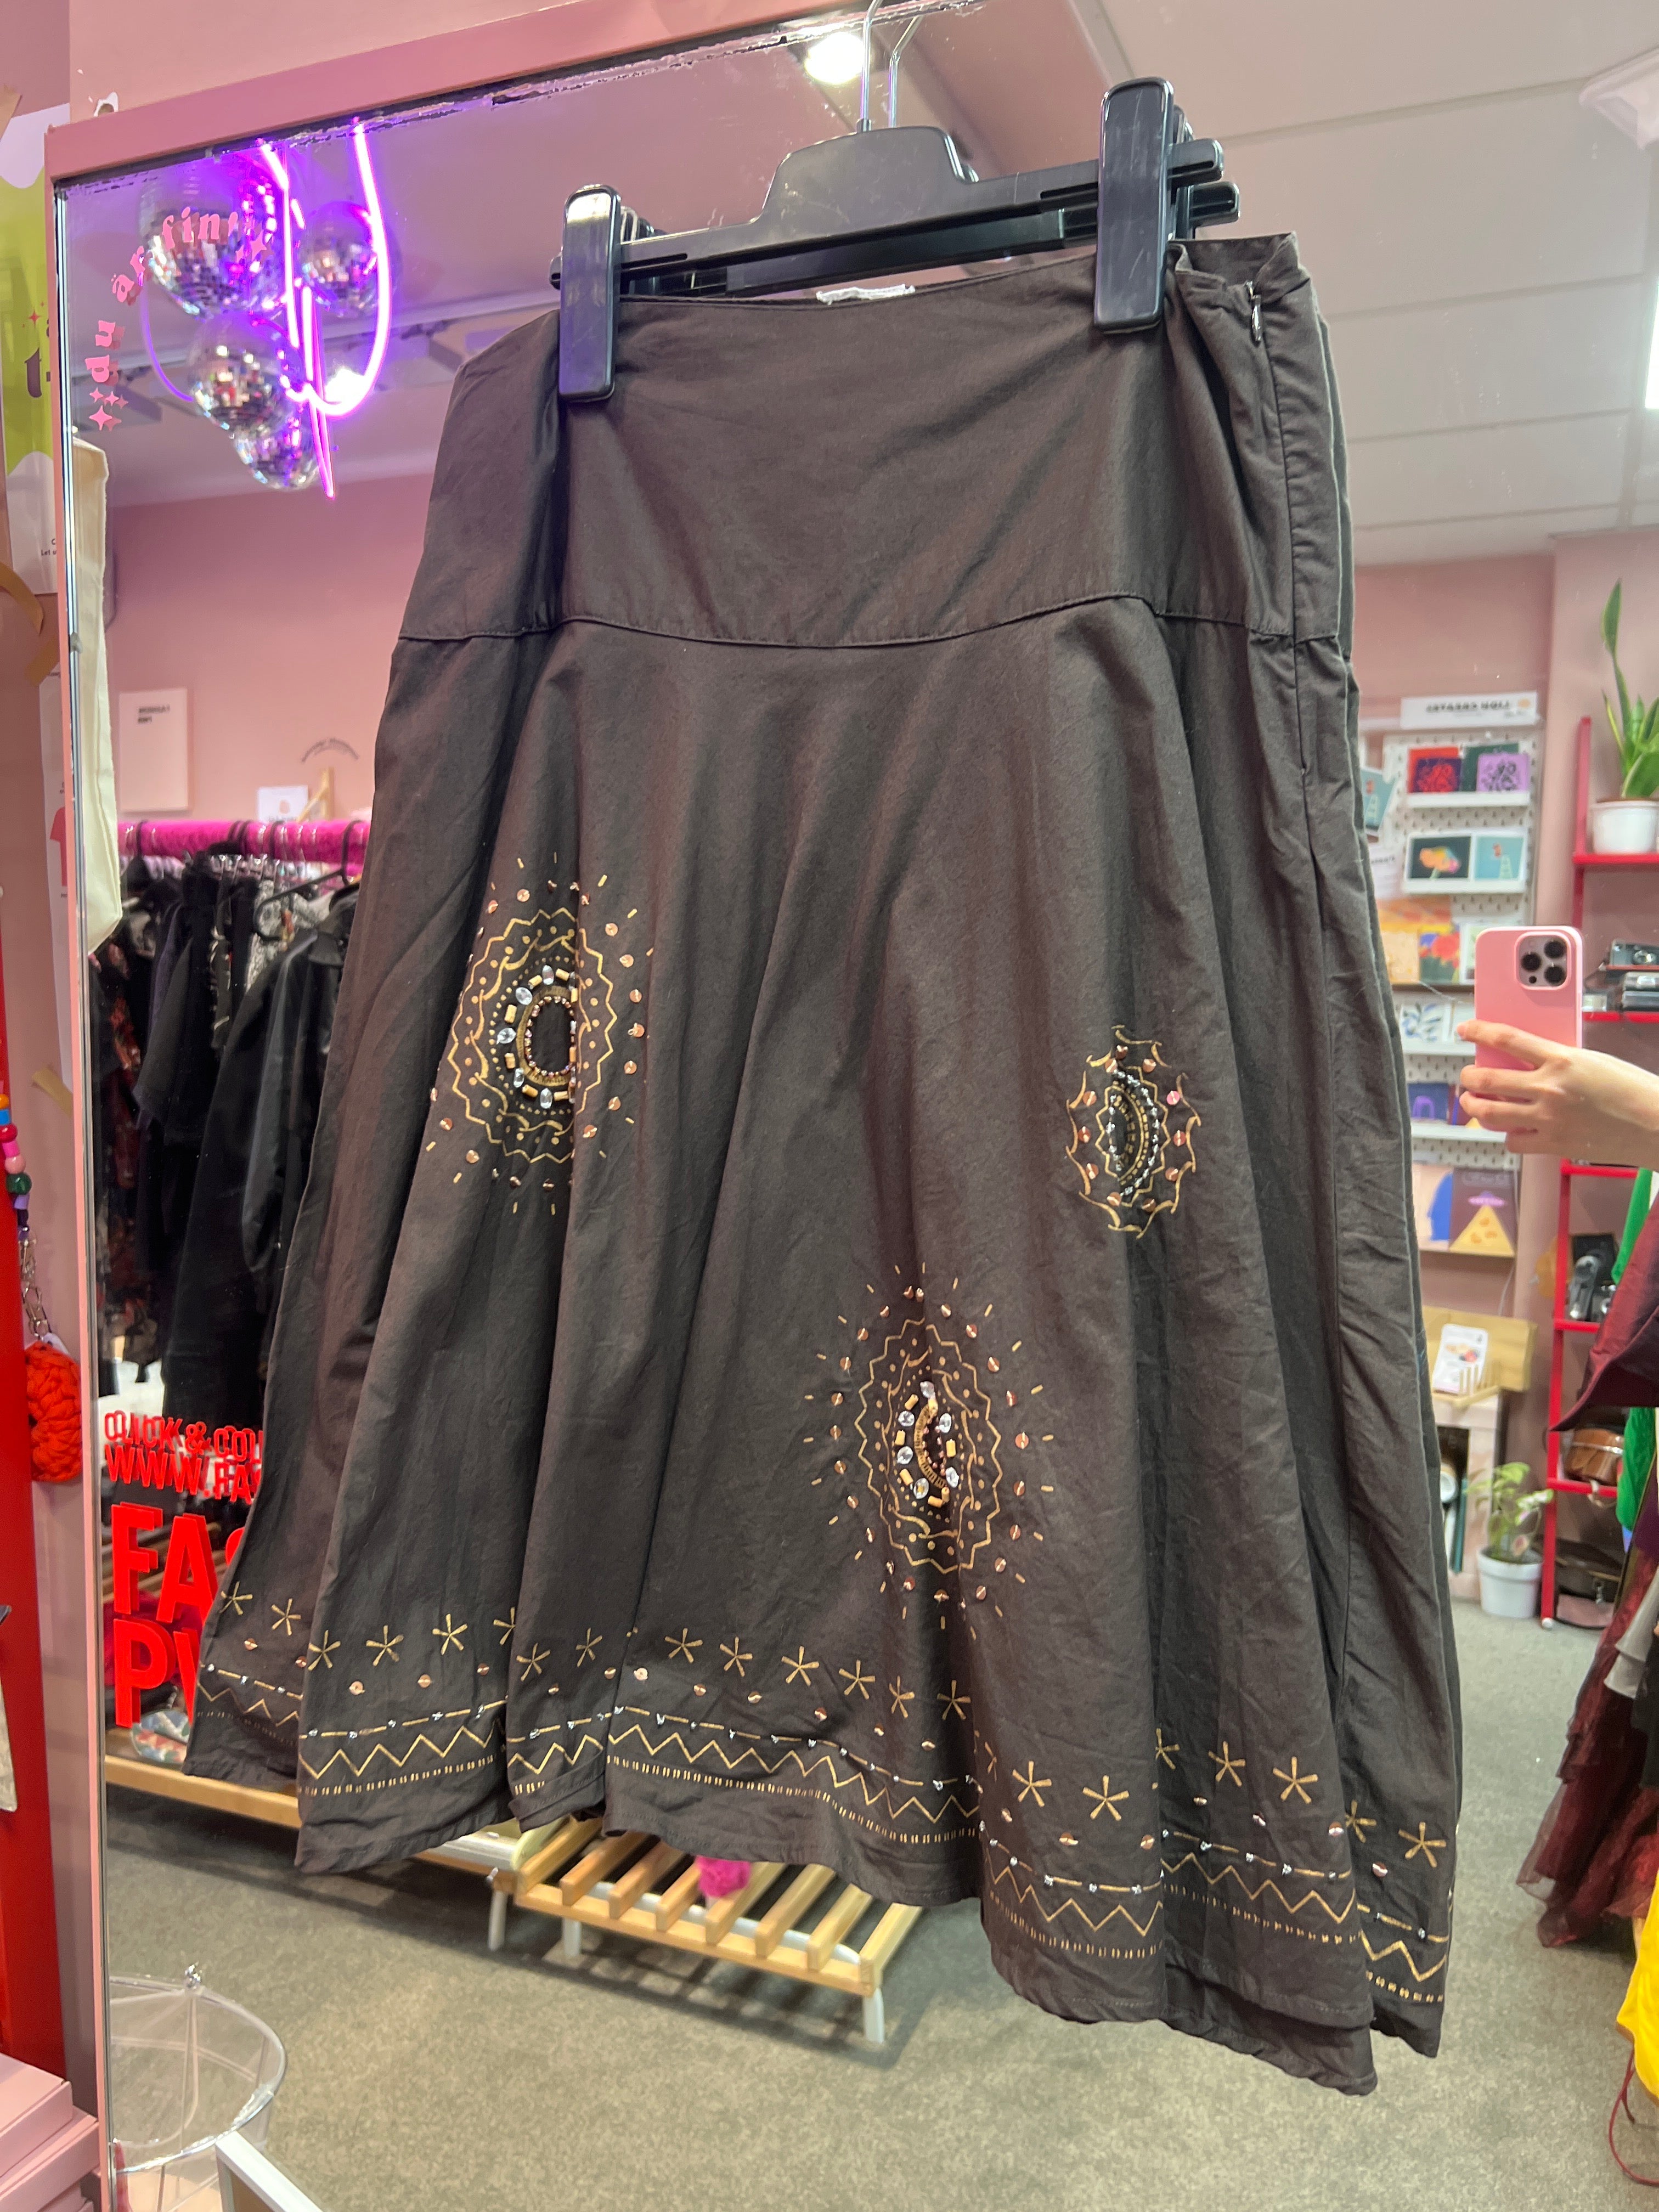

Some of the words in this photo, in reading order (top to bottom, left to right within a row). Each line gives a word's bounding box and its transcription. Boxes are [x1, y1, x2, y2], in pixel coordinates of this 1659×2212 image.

[105, 1413, 176, 1452] CLICK
[185, 1424, 204, 1455] &
[111, 1504, 245, 1627] FA
